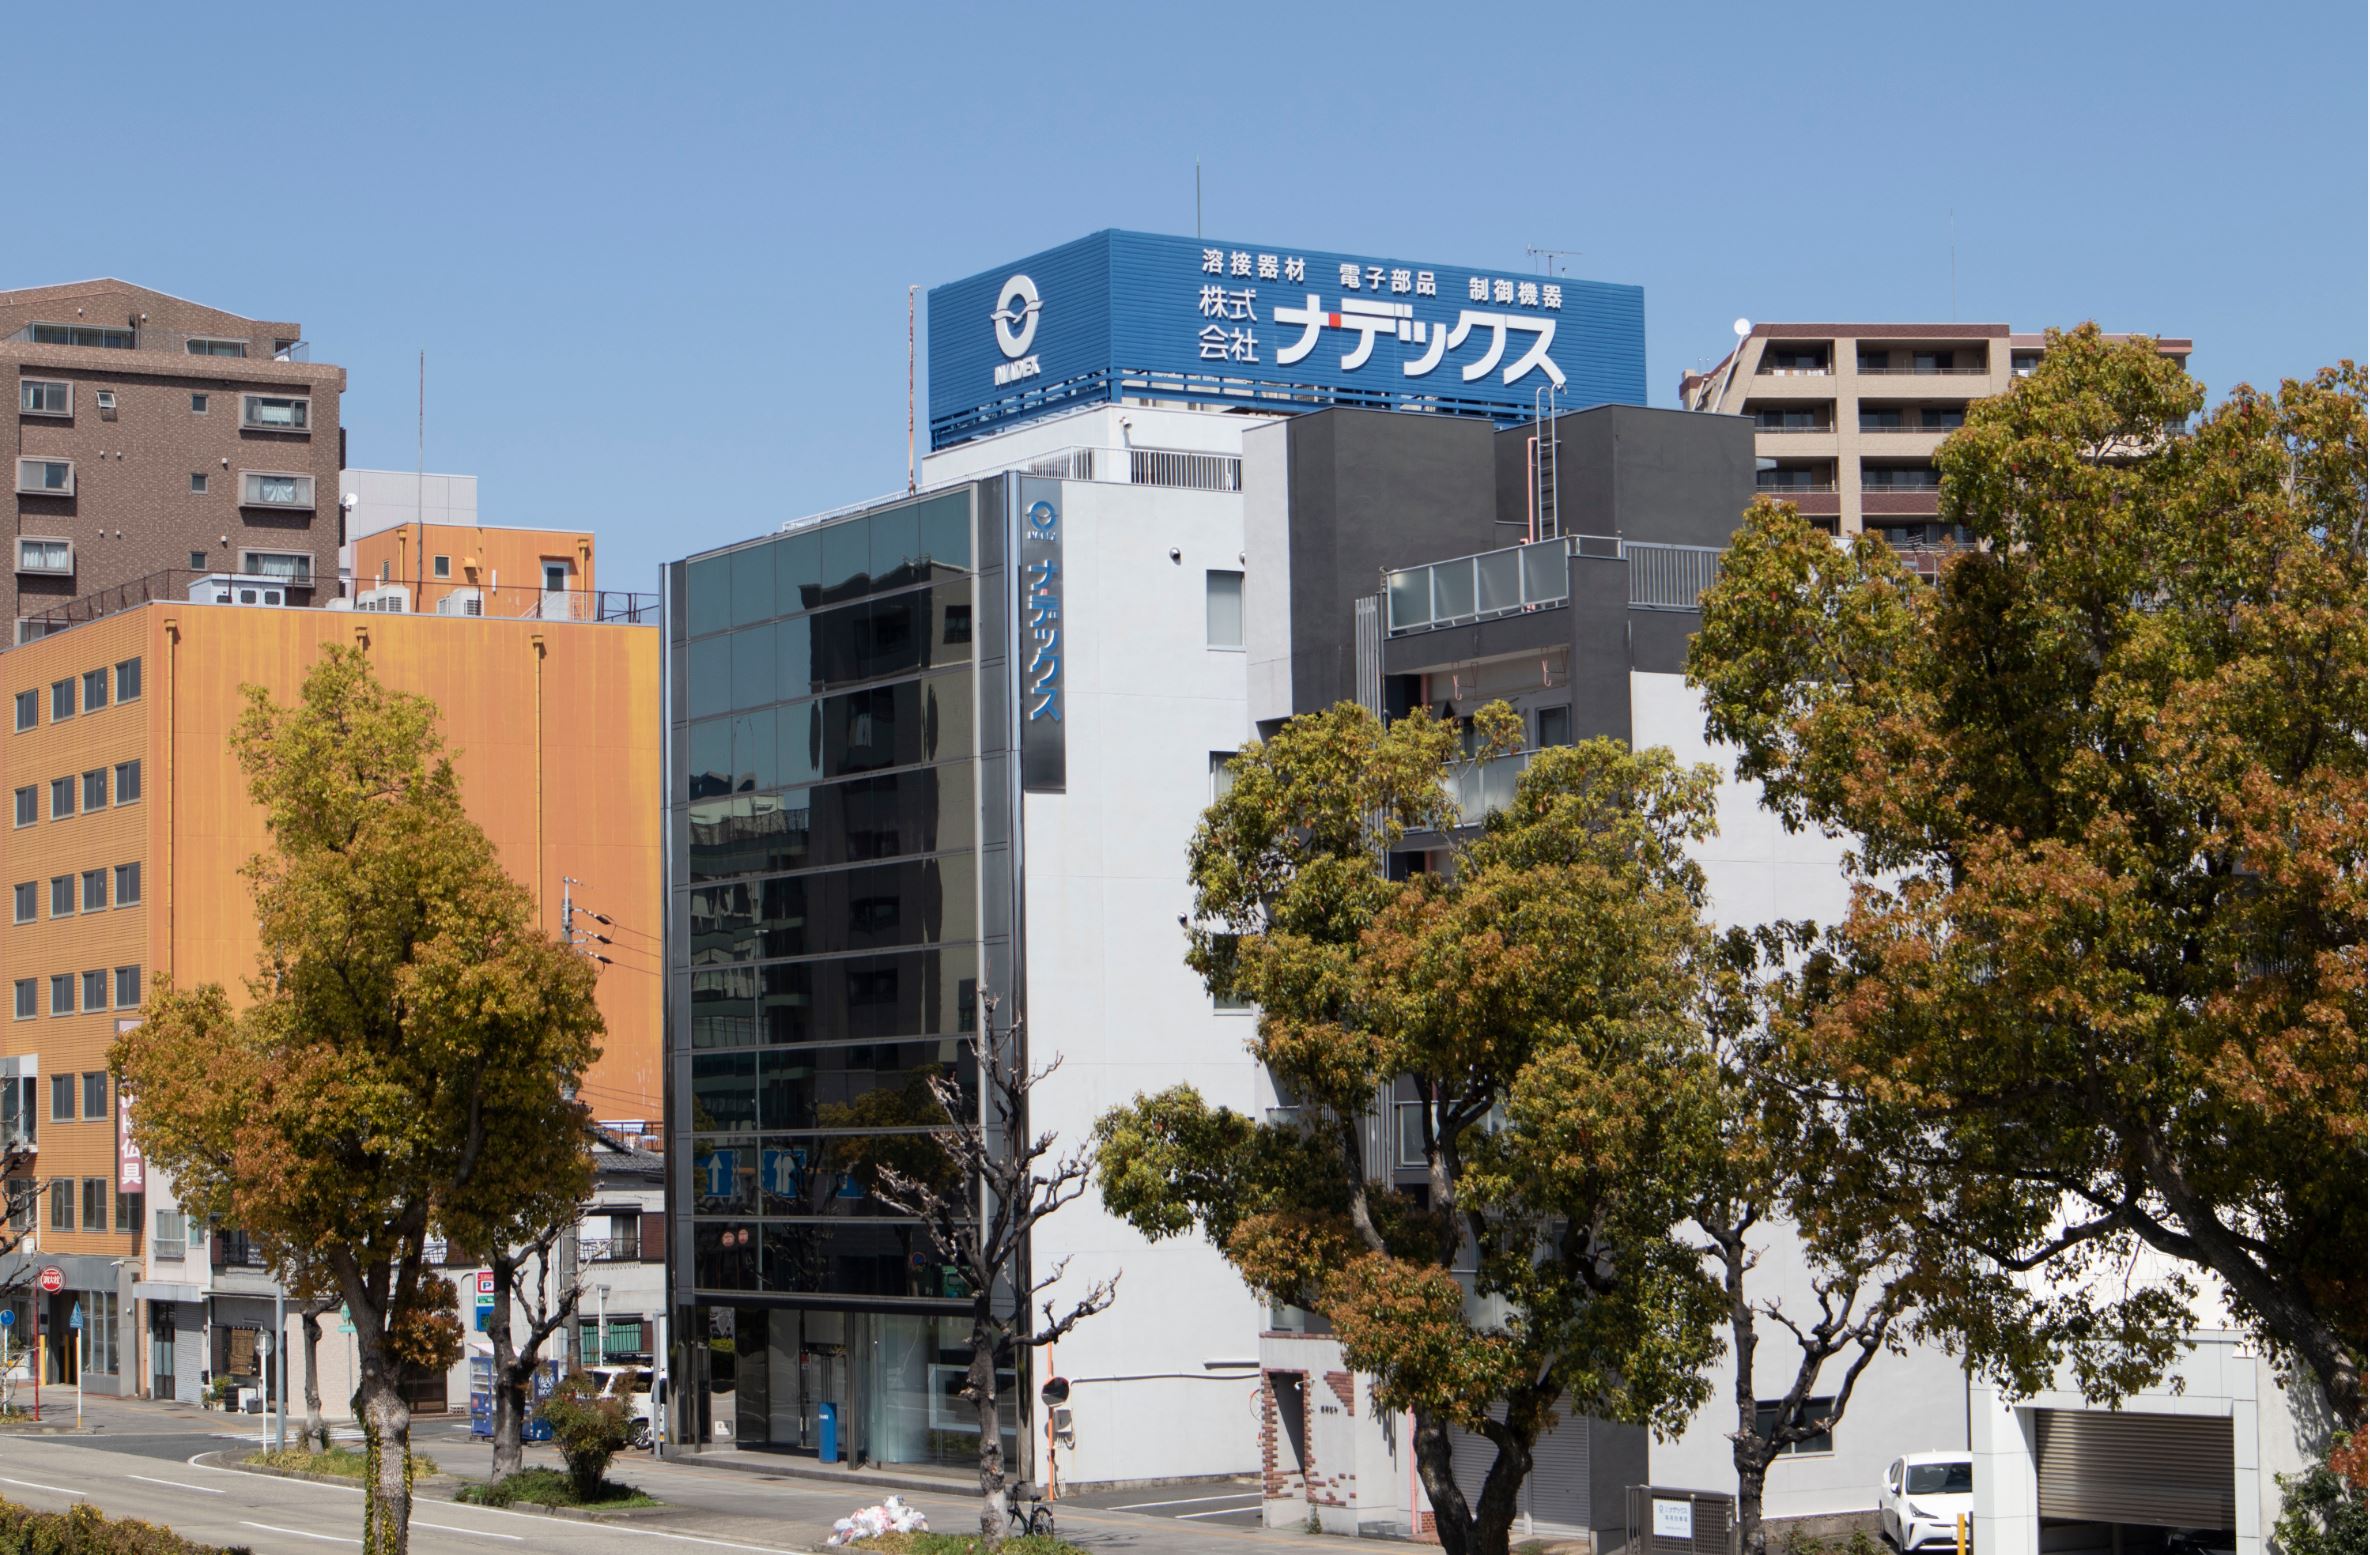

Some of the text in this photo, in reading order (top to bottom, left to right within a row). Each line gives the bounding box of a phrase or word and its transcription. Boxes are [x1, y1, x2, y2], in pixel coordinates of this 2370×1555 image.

[1201, 248, 1563, 309] 溶接器材 電子部品 制御機器
[994, 353, 1041, 386] NADEX
[1273, 293, 1567, 389] ナデックス
[1027, 559, 1063, 722] ナデックス
[482, 1281, 492, 1290] P
